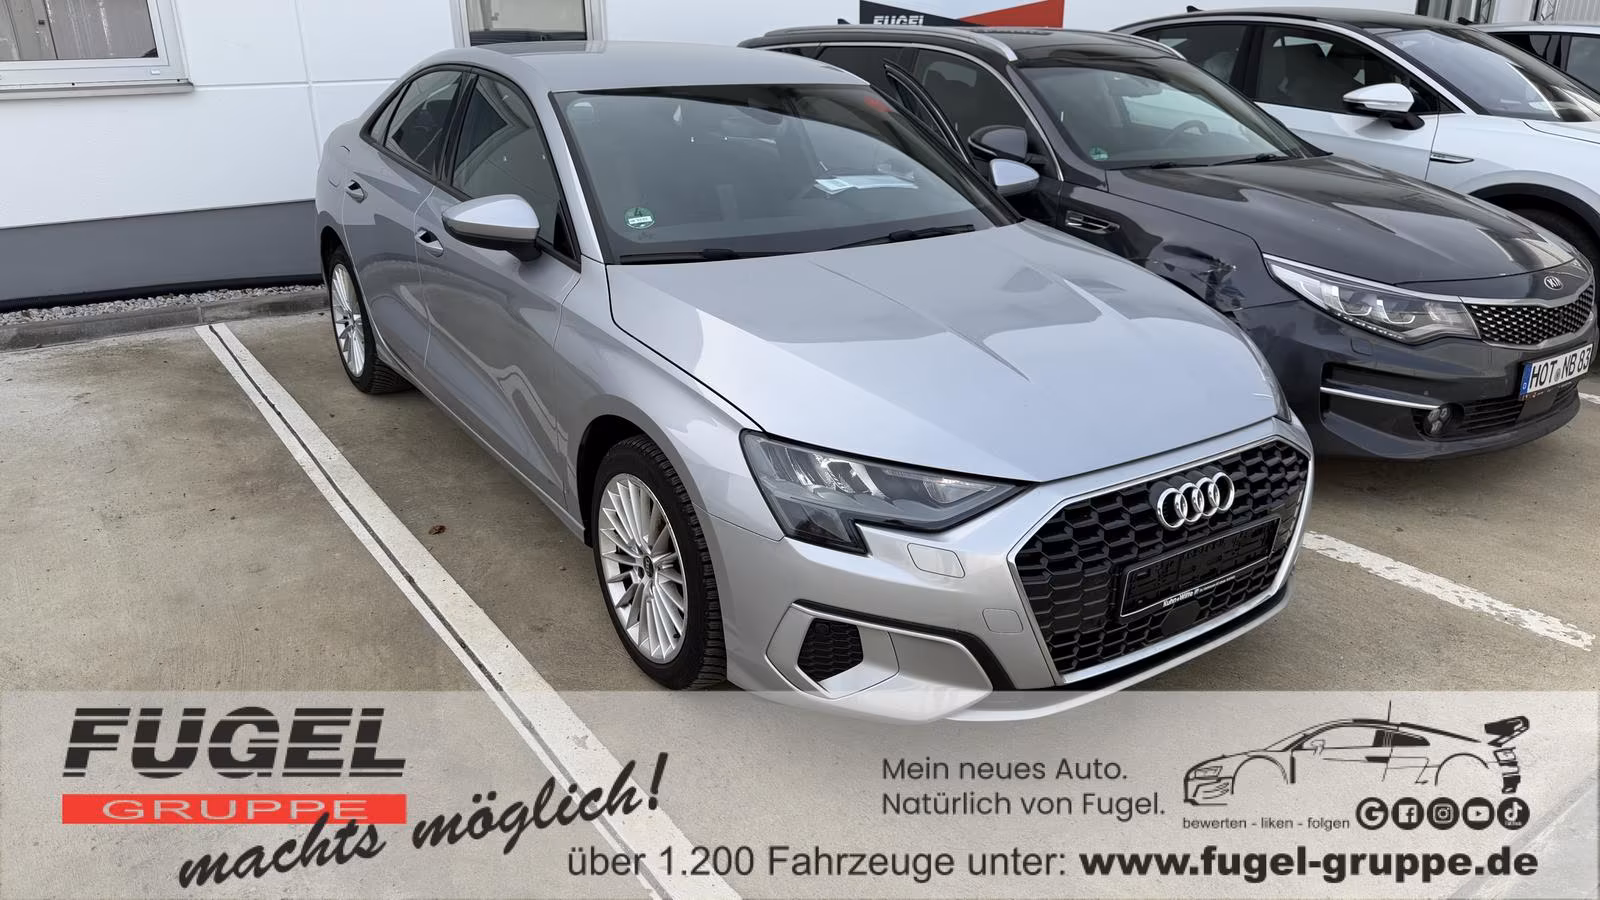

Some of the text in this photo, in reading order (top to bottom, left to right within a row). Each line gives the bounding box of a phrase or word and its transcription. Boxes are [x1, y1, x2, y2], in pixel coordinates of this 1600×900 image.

[1530, 359, 1558, 389] HOT
[1561, 352, 1577, 379] NB
[1577, 347, 1592, 373] 83
